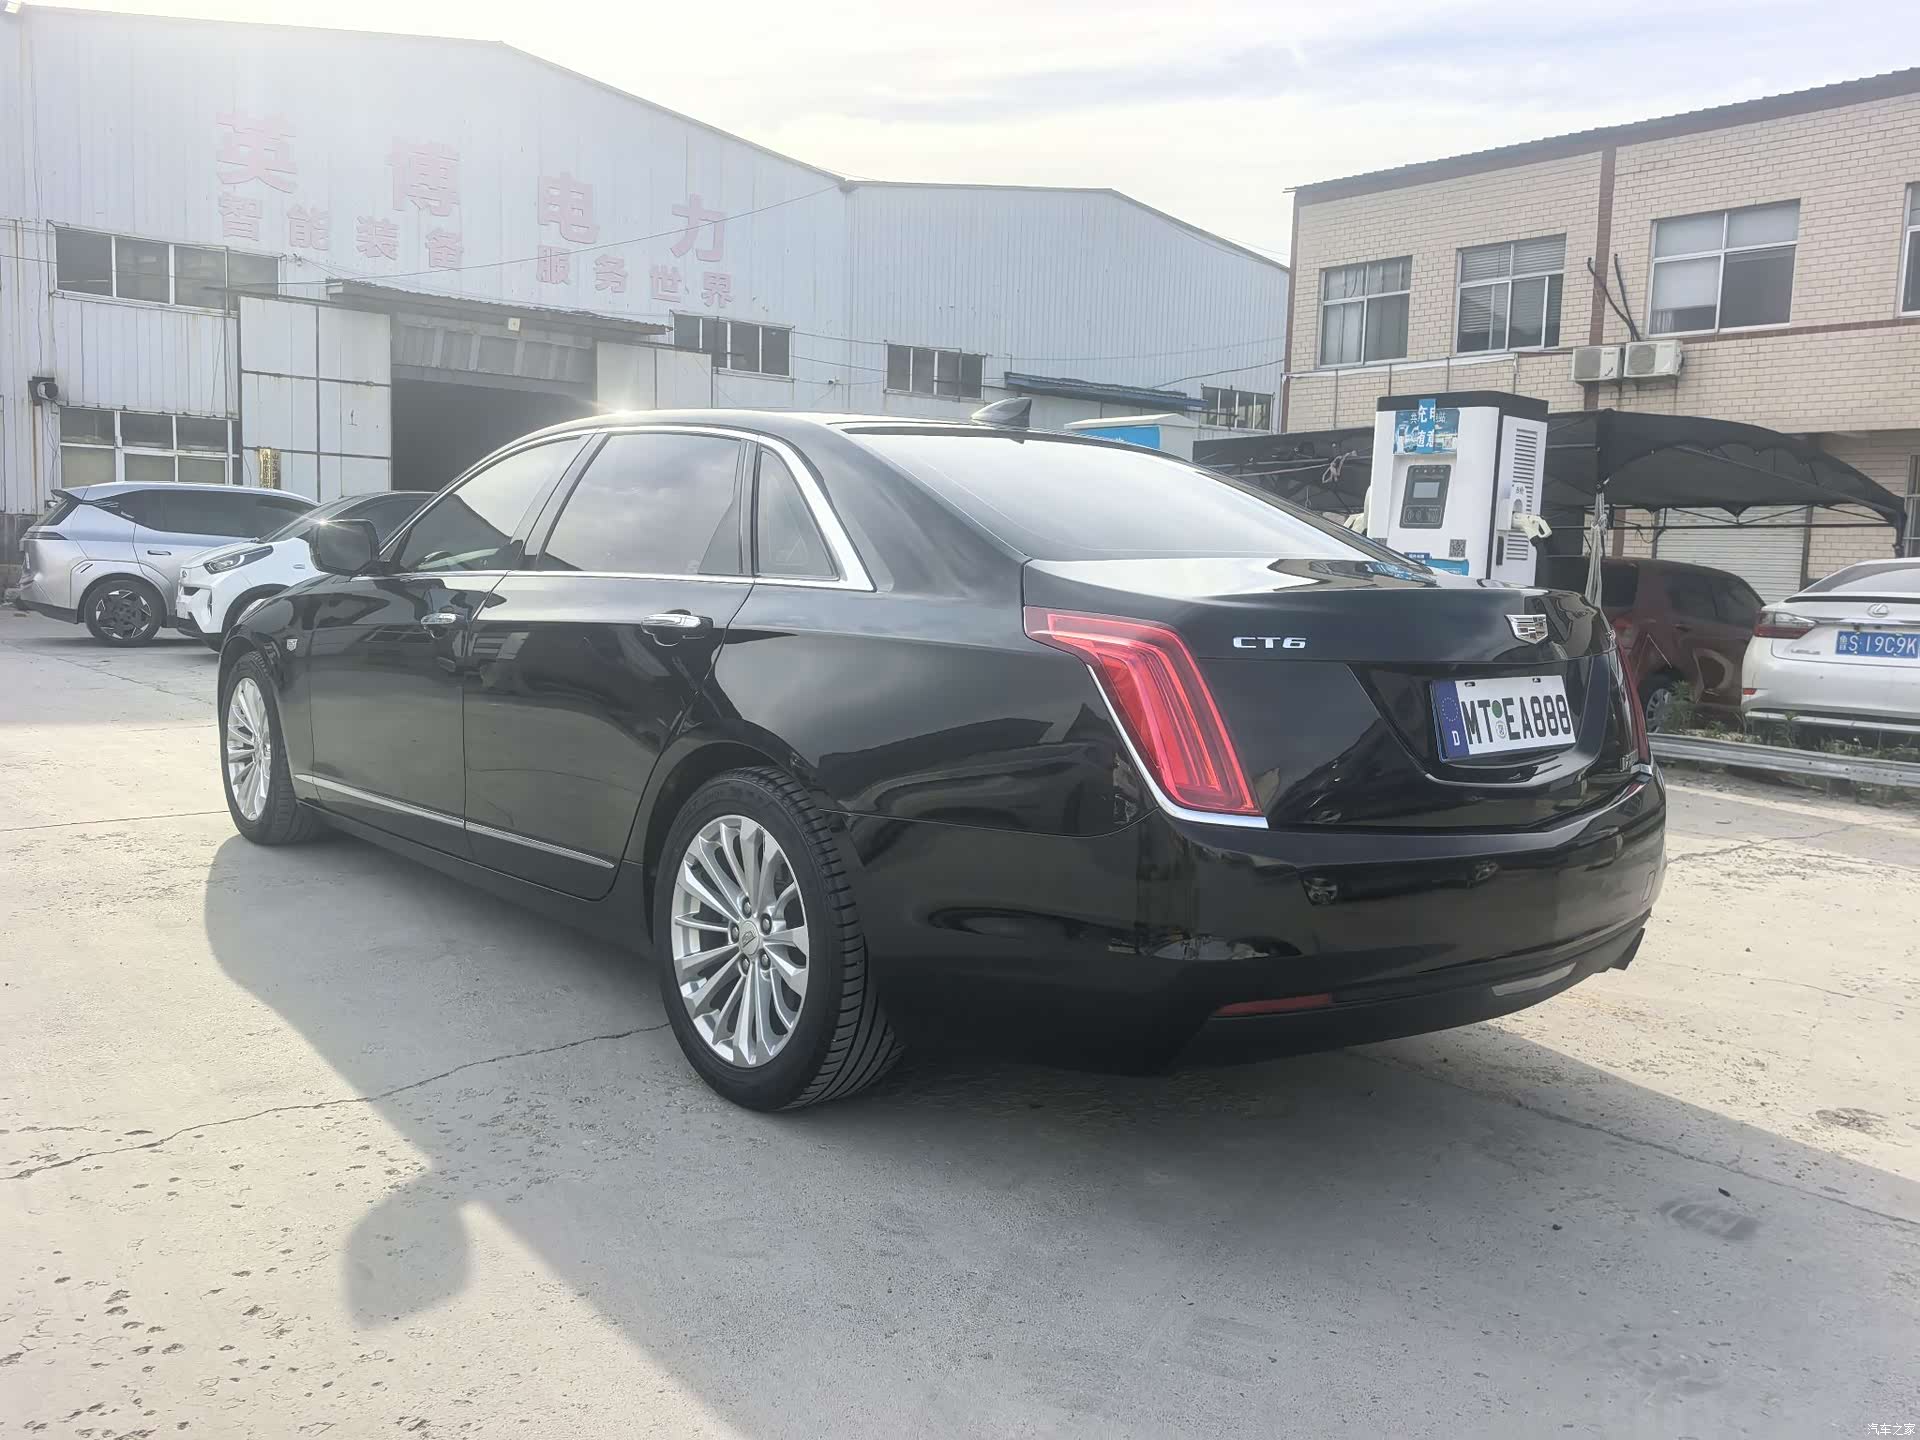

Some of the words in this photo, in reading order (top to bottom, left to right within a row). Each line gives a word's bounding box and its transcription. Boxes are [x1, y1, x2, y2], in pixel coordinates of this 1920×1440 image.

[219, 193, 466, 270] 智能装备
[535, 245, 734, 310] 服务世界
[1233, 636, 1307, 649] CT6
[1461, 699, 1494, 745] MT
[1502, 694, 1571, 740] EA888
[1451, 730, 1461, 747] D
